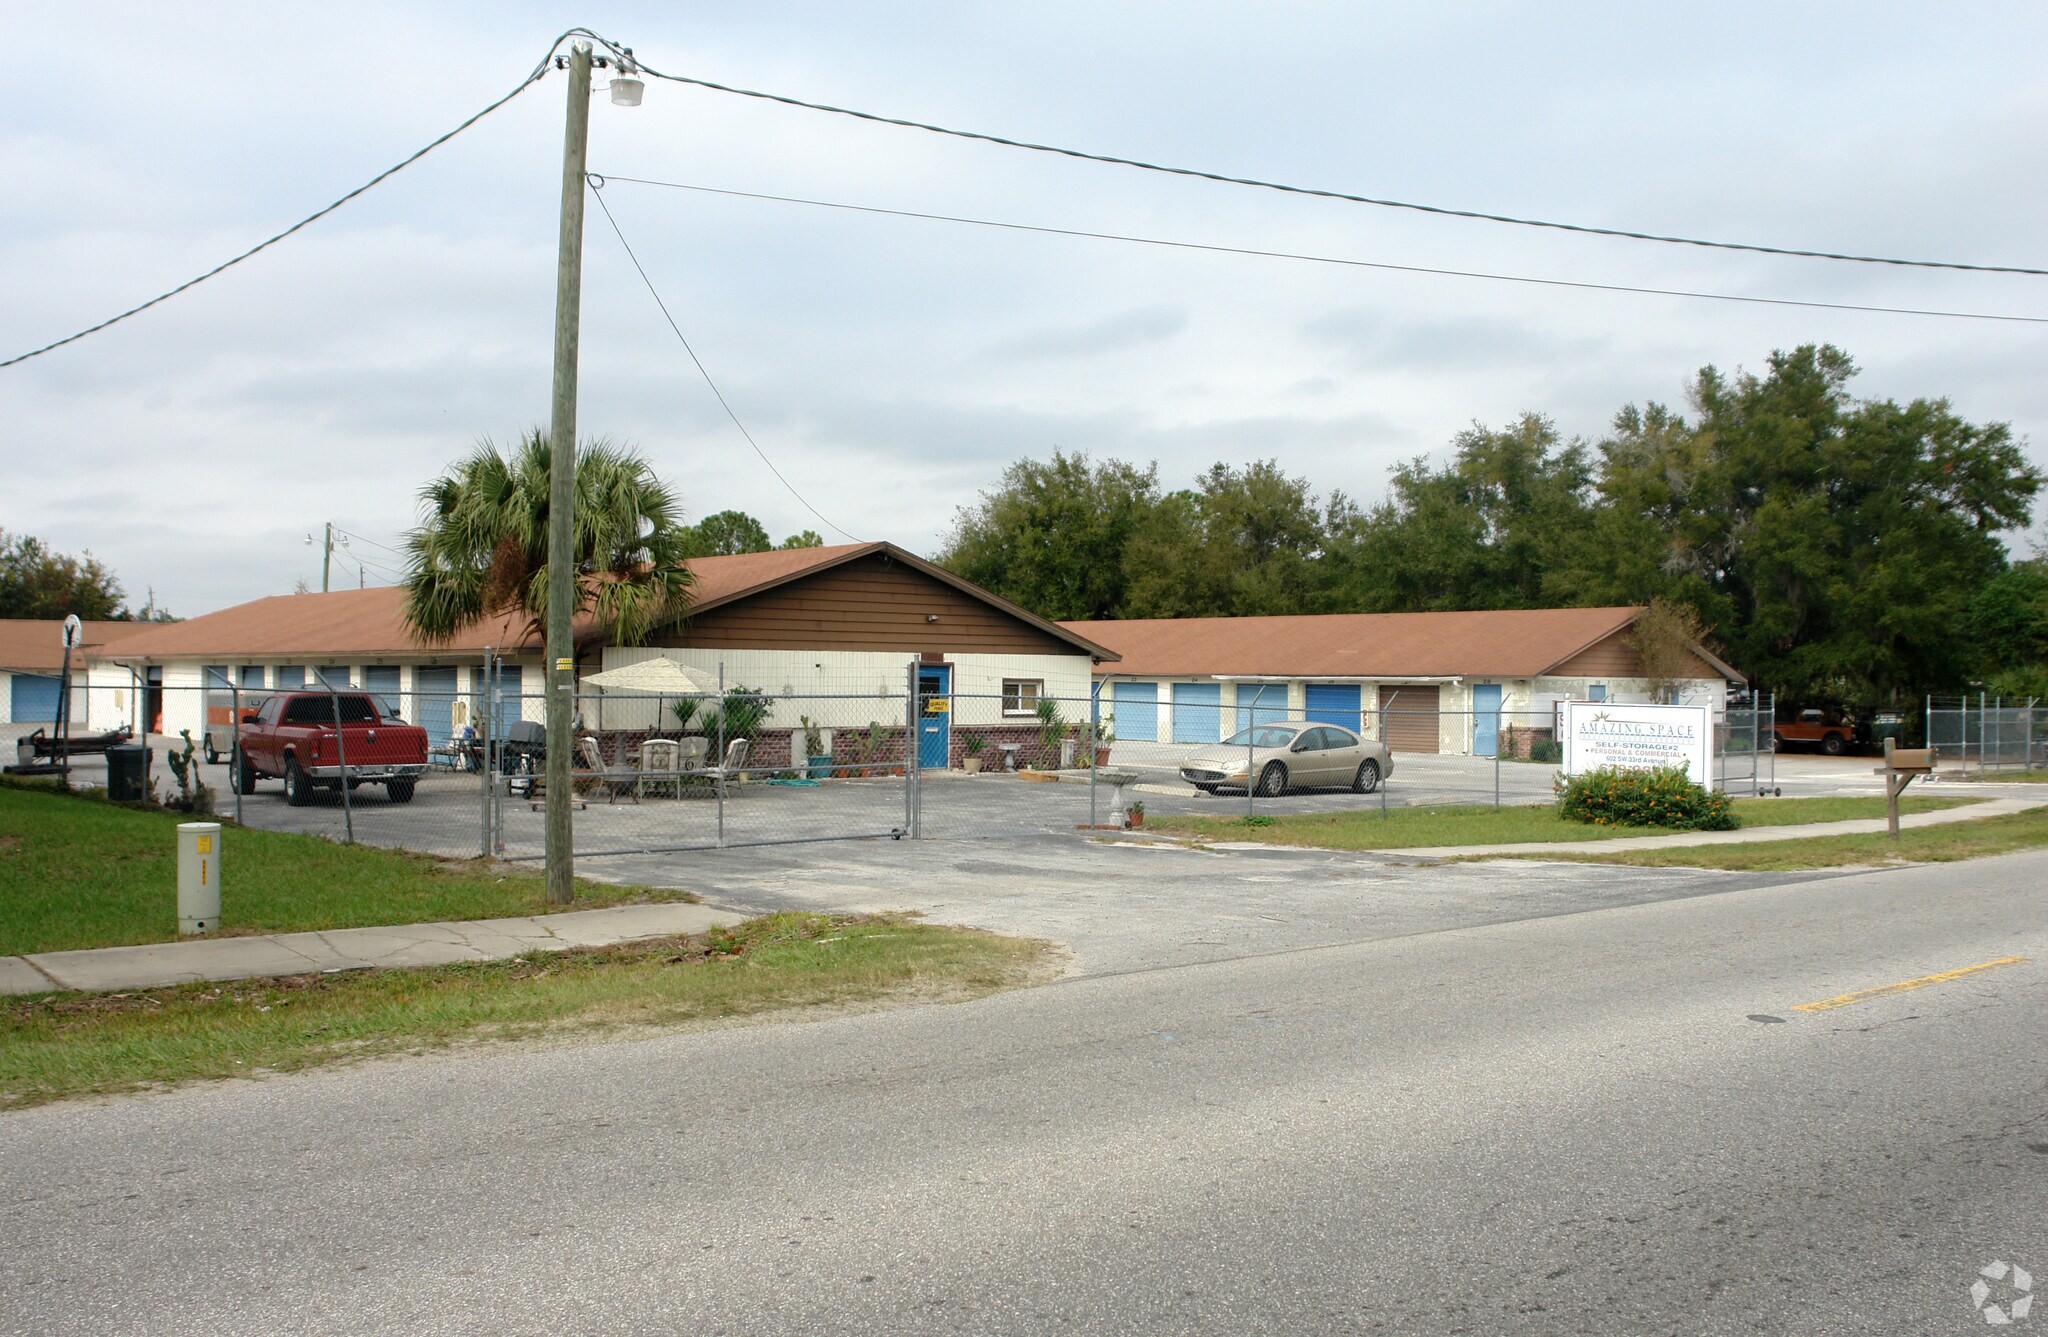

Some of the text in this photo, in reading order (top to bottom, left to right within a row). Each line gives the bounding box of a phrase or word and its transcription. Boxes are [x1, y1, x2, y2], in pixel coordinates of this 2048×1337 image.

[1579, 722, 1694, 736] AMAZING SPACE
[1590, 747, 1626, 756] PERSONAL
[1634, 749, 1682, 758] COMMERCIAL
